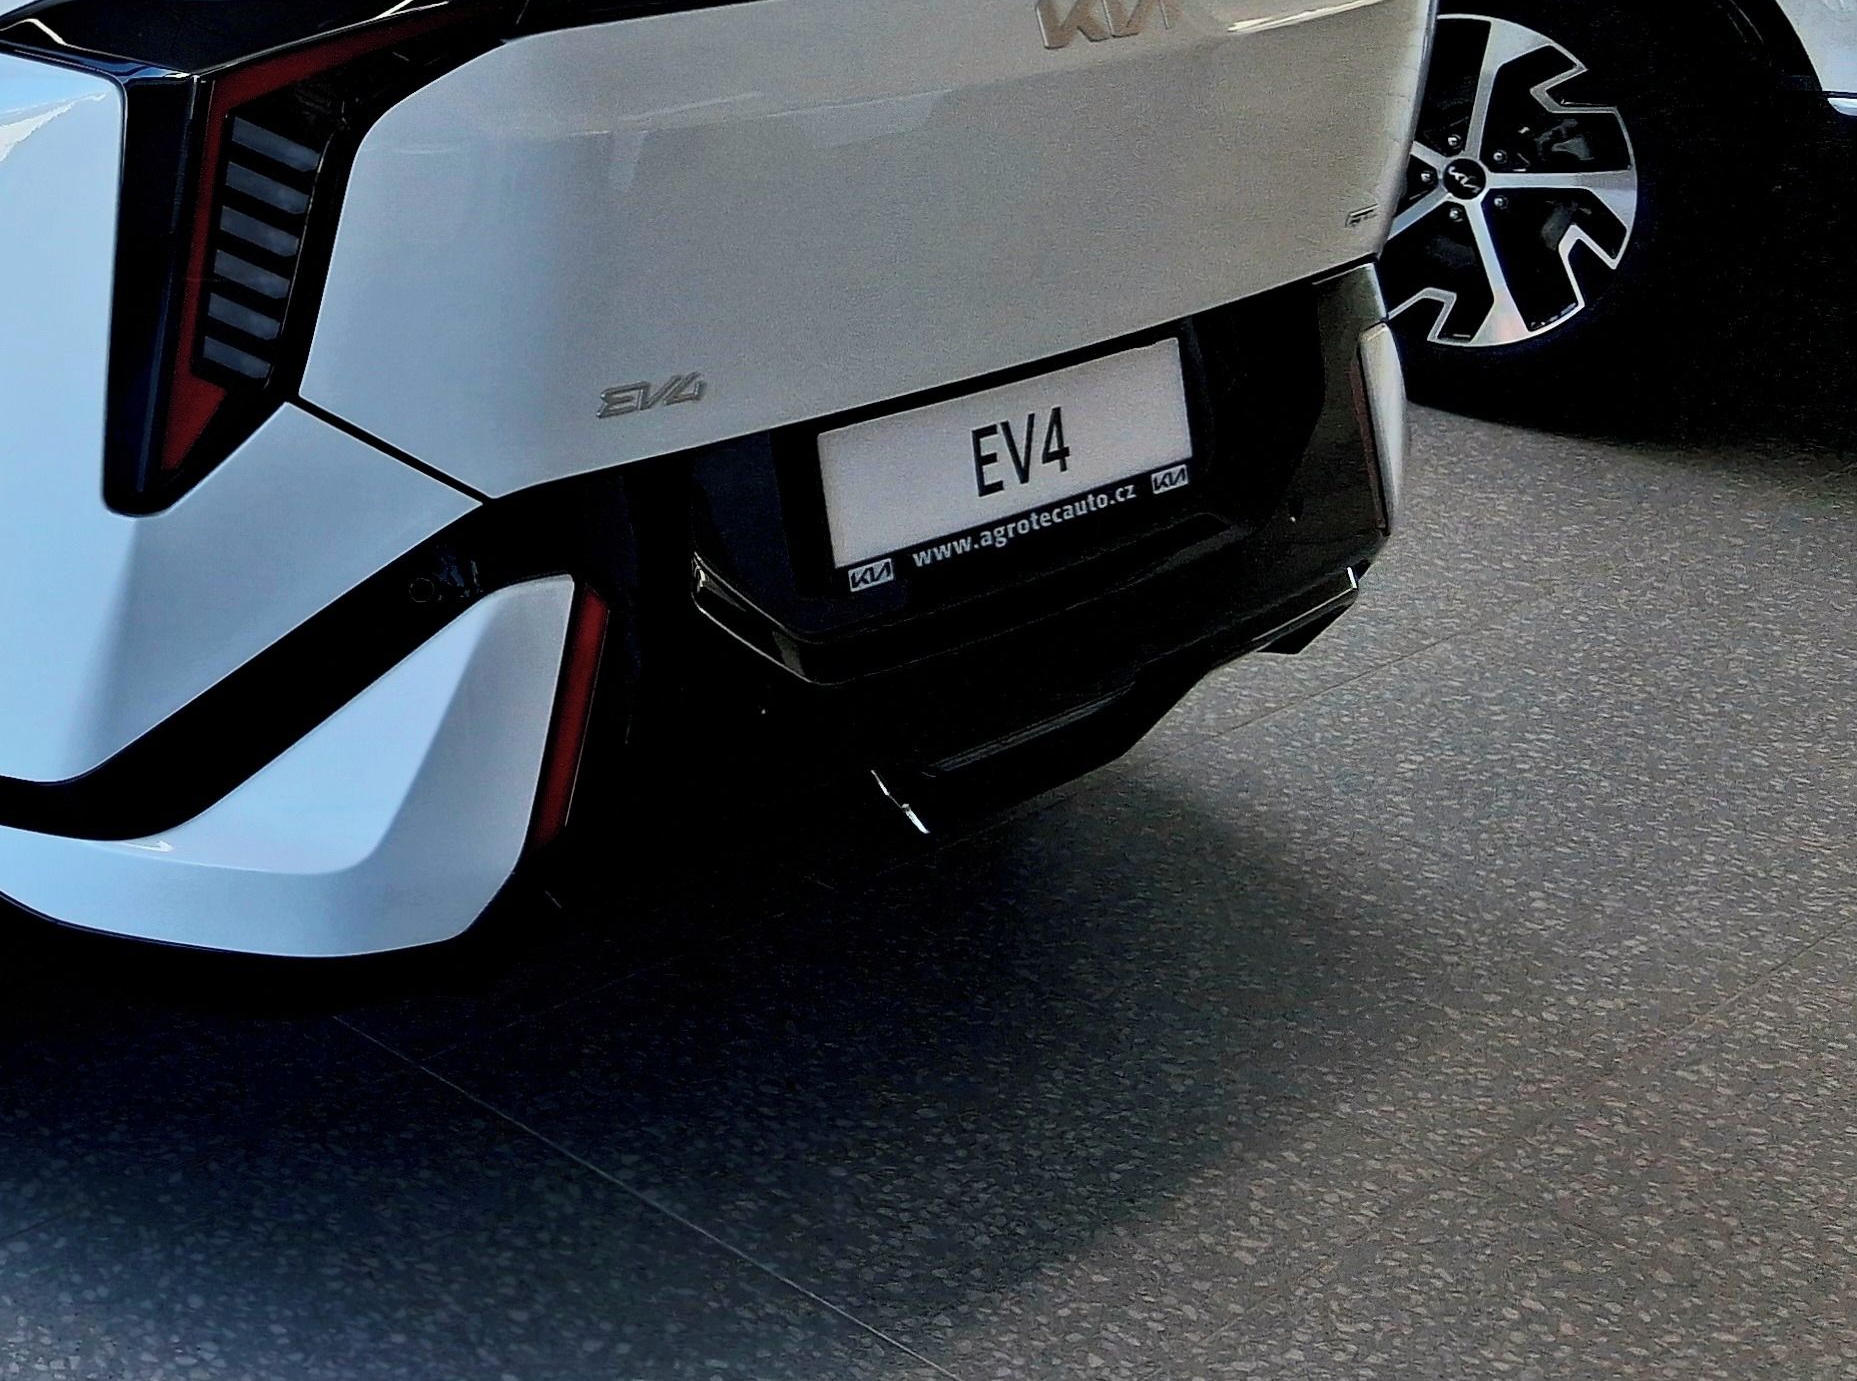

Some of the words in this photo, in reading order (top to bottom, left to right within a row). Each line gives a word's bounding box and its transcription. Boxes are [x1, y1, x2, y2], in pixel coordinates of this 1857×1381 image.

[595, 371, 707, 419] EV4
[971, 406, 1070, 498] EV4
[1152, 466, 1188, 492] KIA
[911, 484, 1137, 568] www.agrotecauto.cz
[849, 560, 893, 590] KIA
